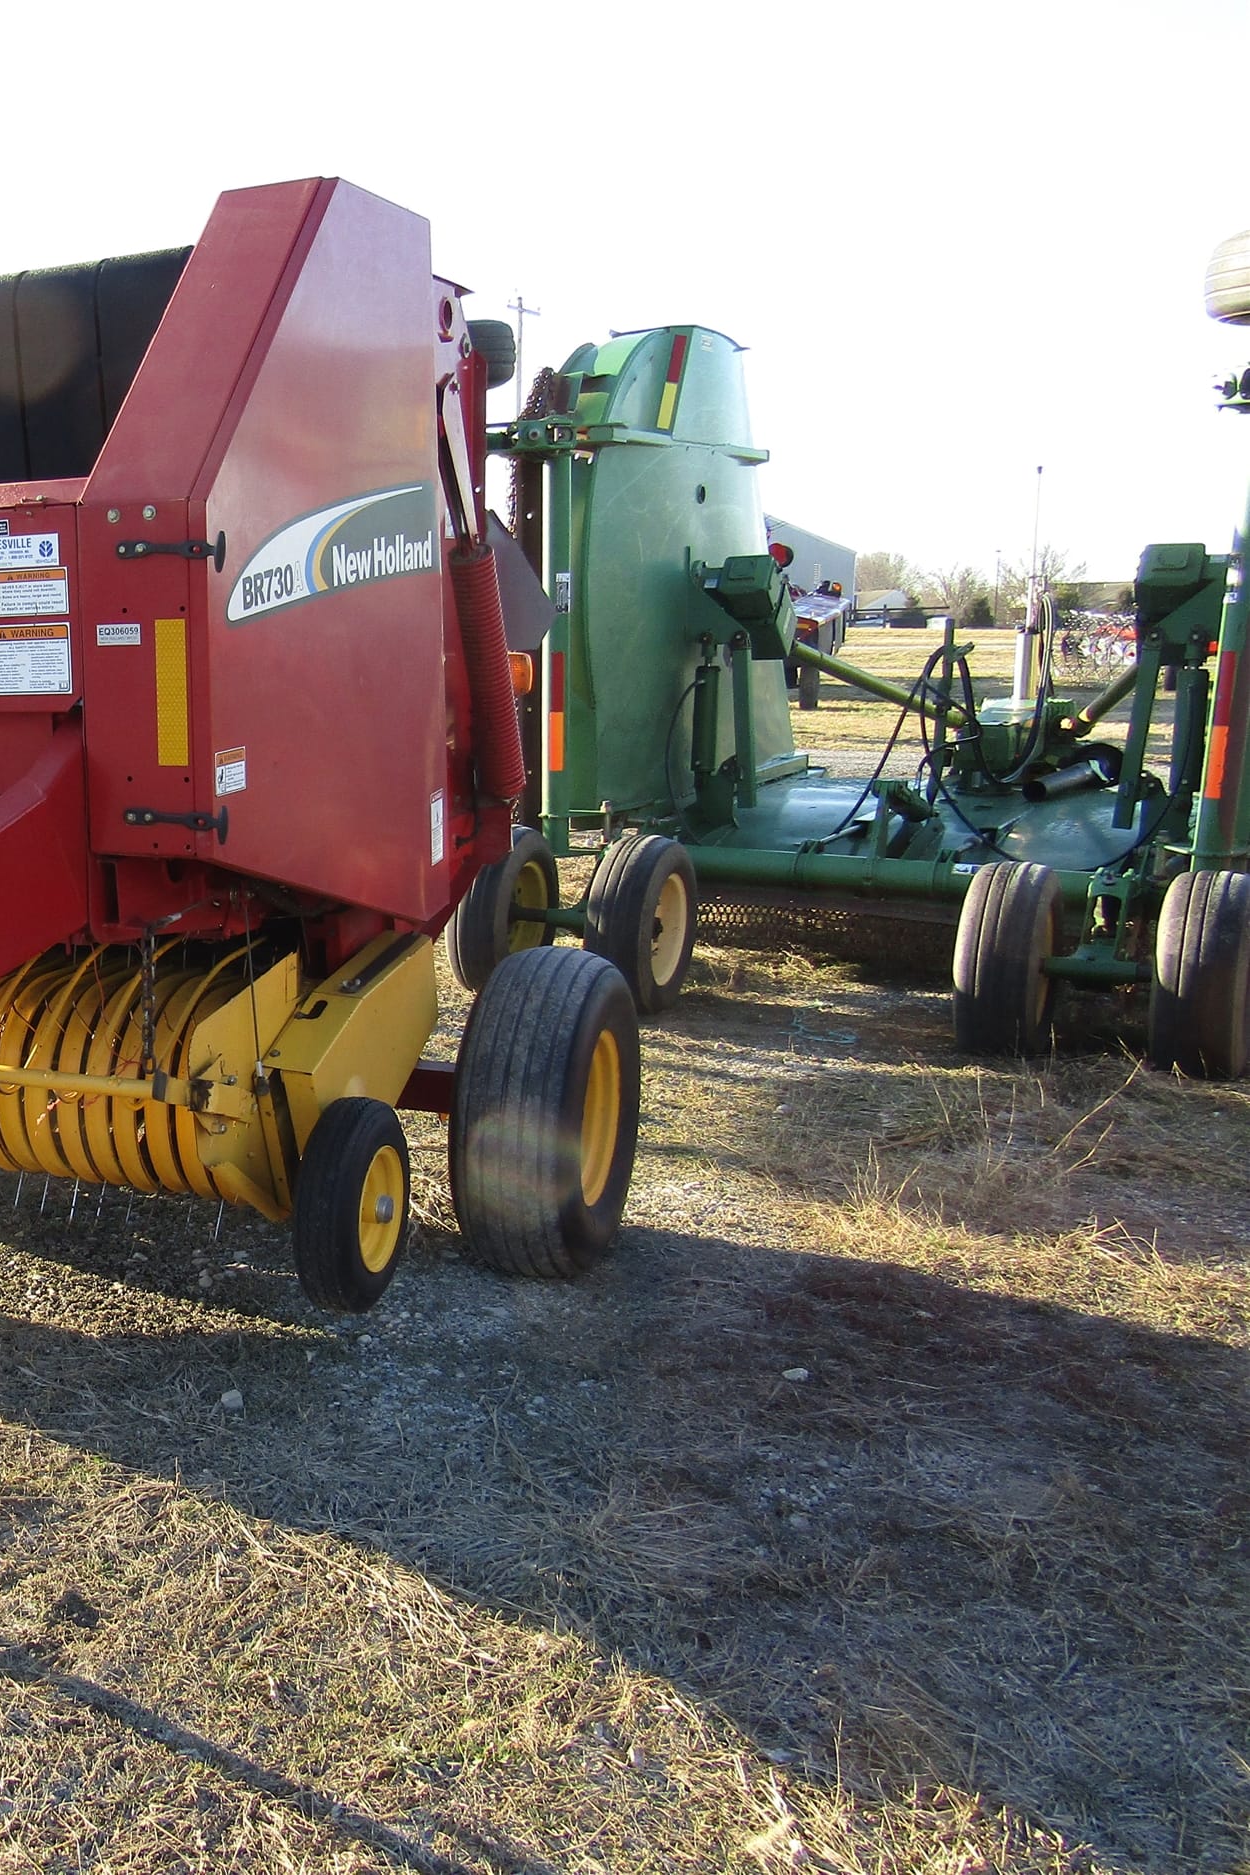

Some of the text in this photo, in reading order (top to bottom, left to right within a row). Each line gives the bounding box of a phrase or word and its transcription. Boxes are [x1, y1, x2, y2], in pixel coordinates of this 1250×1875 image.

[332, 530, 432, 587] New Holland
[16, 572, 51, 580] WARNING
[10, 628, 54, 638] WARNING
[98, 626, 139, 636] EQ306059
